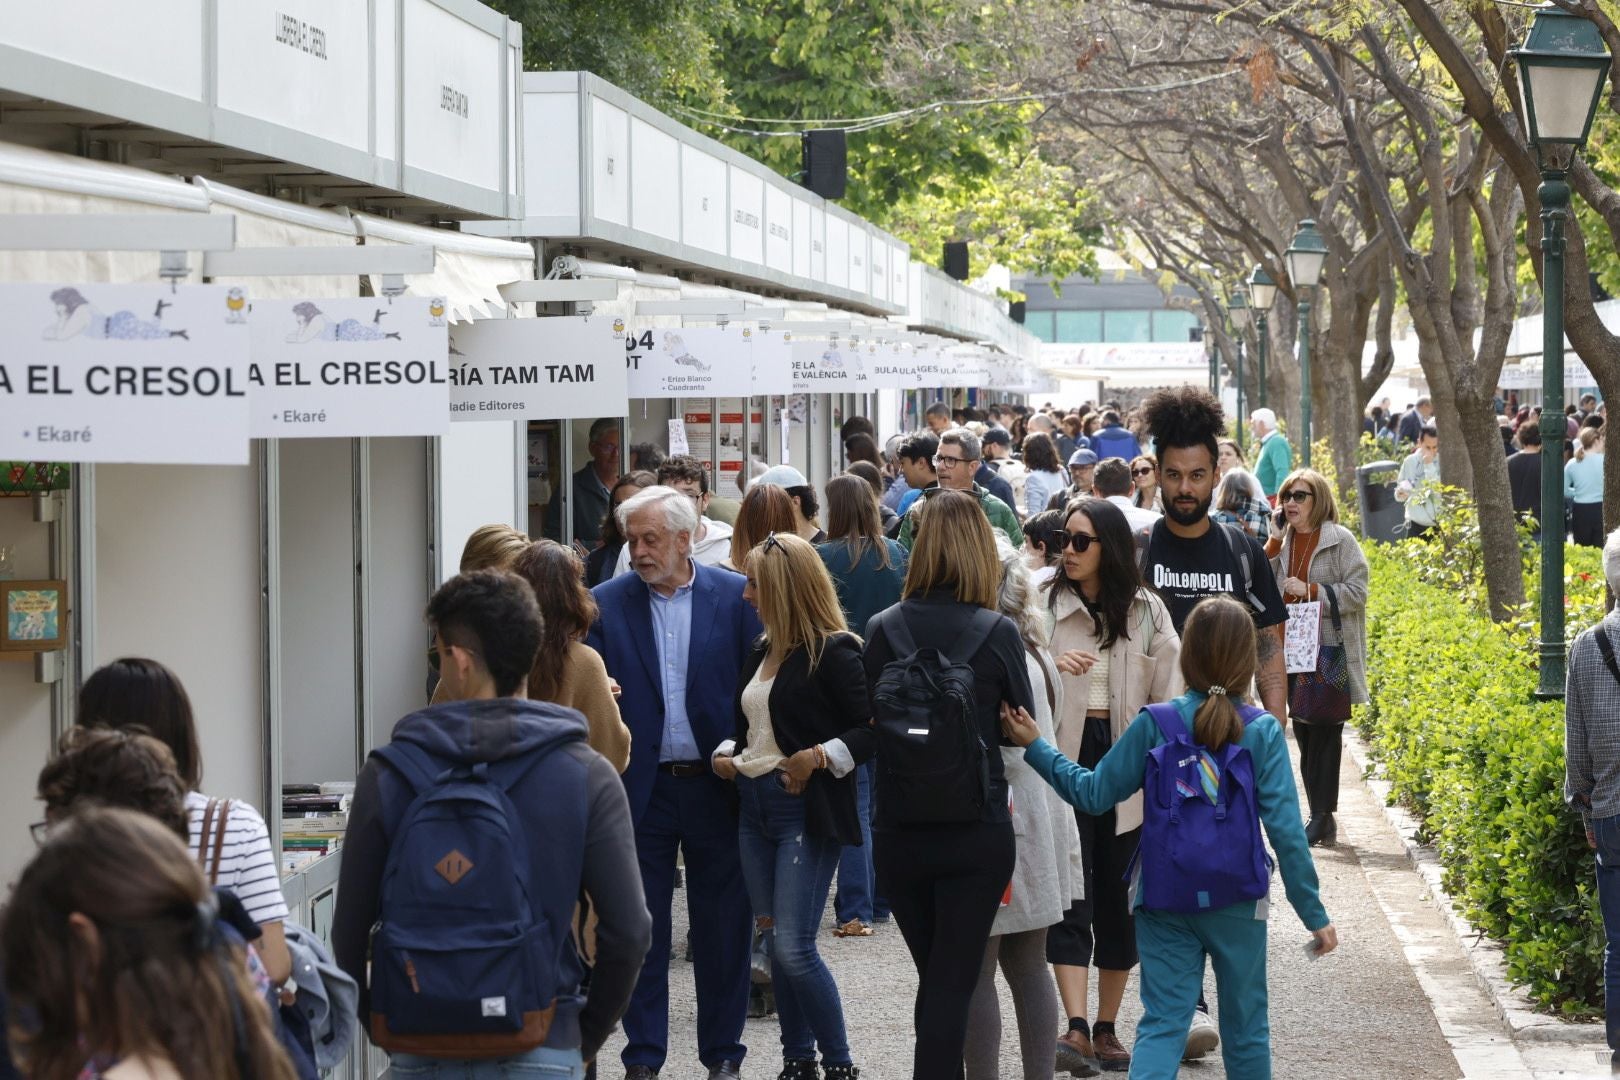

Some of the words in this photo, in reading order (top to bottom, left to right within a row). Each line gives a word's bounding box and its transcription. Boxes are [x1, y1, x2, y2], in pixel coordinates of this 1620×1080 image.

[275, 363, 311, 386] EL
[320, 360, 446, 385] CRESOL
[804, 361, 816, 369] LA
[28, 365, 72, 394] EL
[86, 365, 246, 396] CRESOL
[488, 366, 538, 385] TAM
[544, 364, 594, 383] TAM
[449, 401, 476, 412] adie
[478, 400, 525, 411] Editores
[283, 410, 326, 423] Ekaré
[37, 426, 92, 442] Ekaré
